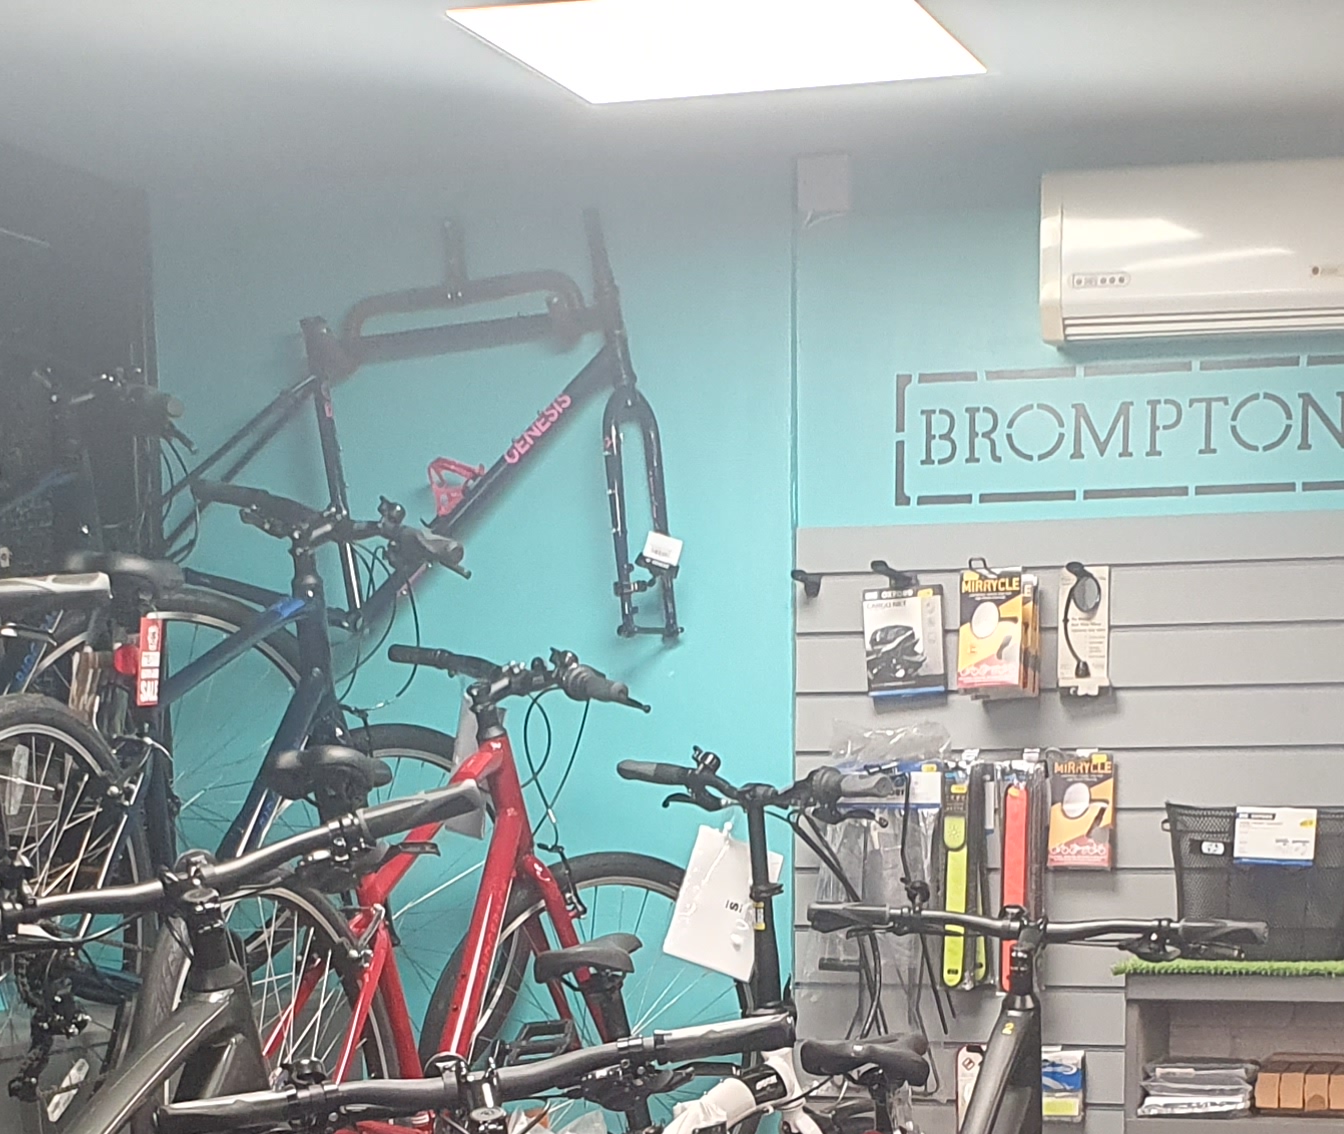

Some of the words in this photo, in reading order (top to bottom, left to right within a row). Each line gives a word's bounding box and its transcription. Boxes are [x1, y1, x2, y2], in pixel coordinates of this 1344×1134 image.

[504, 394, 572, 464] GENESIS
[961, 577, 1021, 593] MIRRYCLE
[1054, 761, 1113, 775] MIRRYCLE
[1001, 1022, 1015, 1035] 2
